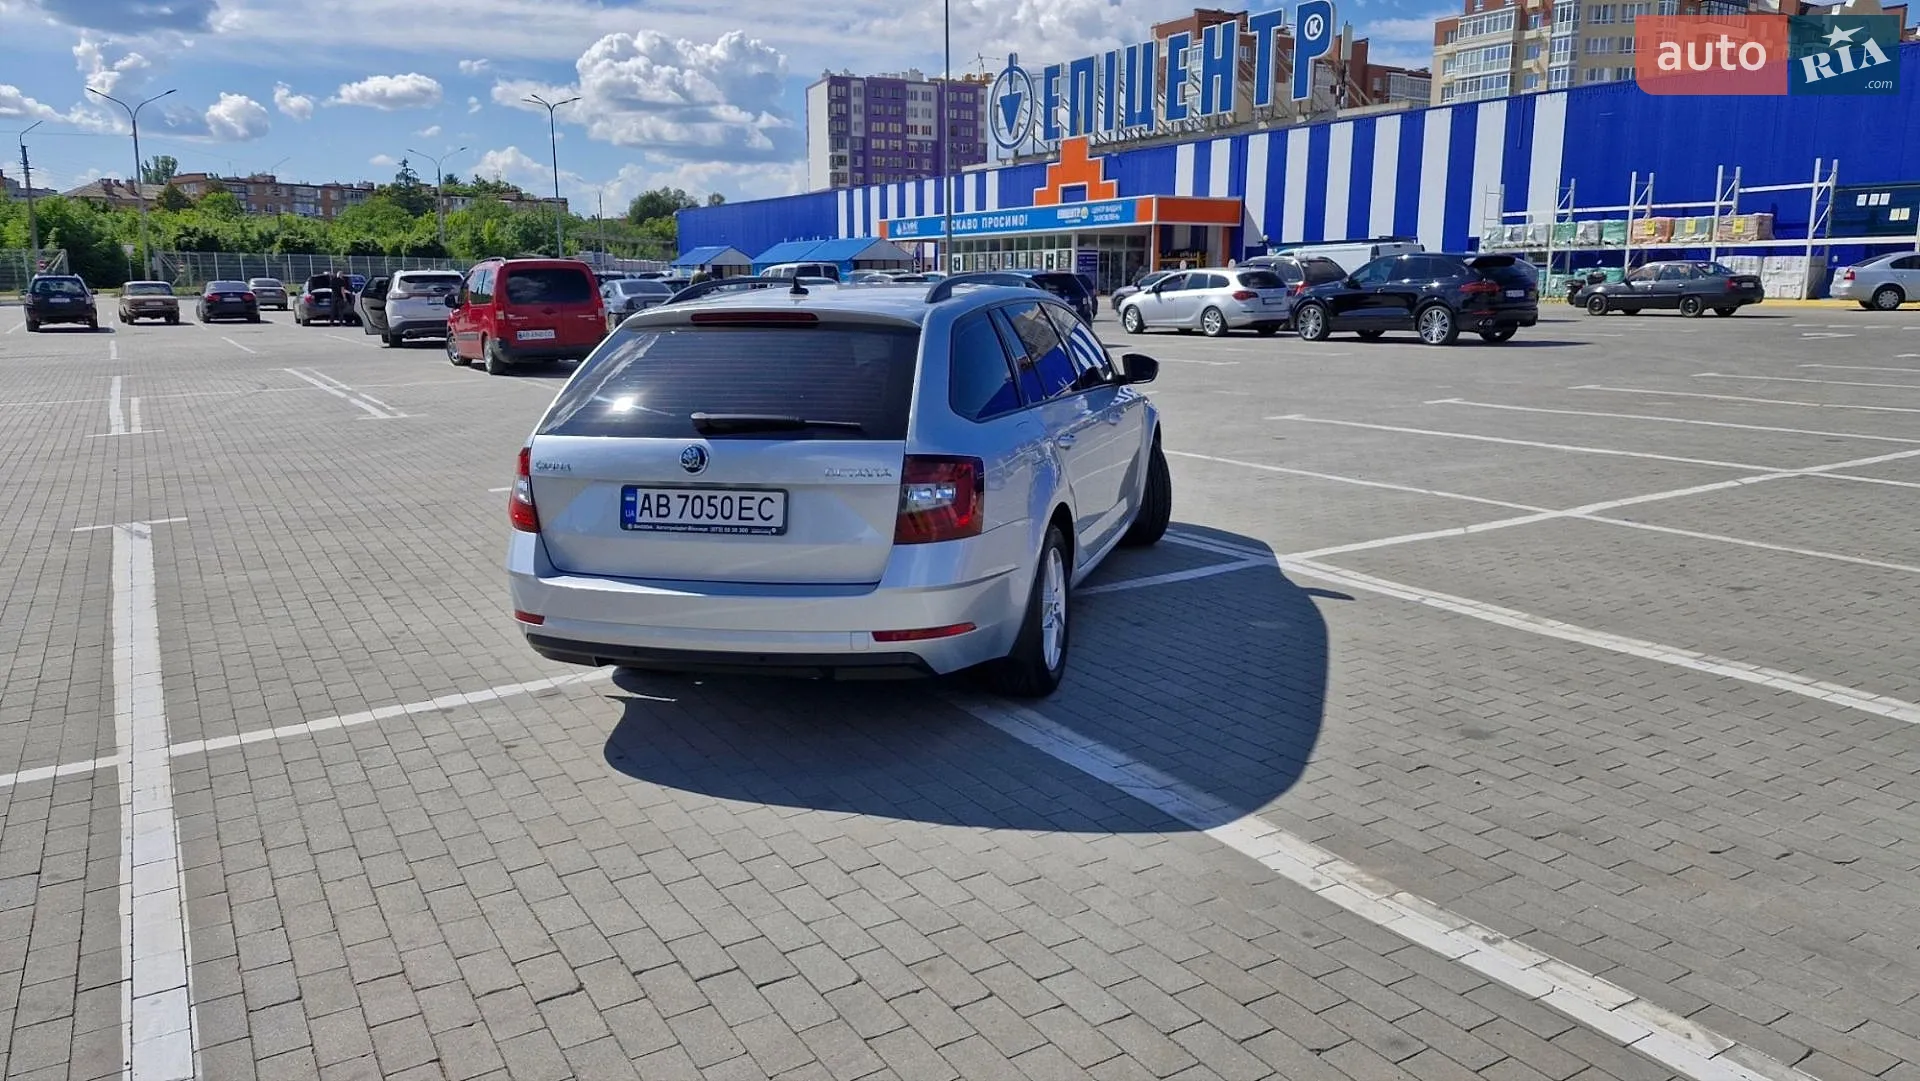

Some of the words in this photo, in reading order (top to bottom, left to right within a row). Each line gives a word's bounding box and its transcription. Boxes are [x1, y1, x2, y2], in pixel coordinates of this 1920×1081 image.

[1043, 0, 1336, 142] ЕПІЦЕНТР
[940, 217, 978, 232] ЛСКАВО
[981, 214, 1029, 229] ПРОСИМО!
[639, 493, 671, 518] AB
[676, 494, 734, 520] 7050
[738, 496, 775, 521] EC
